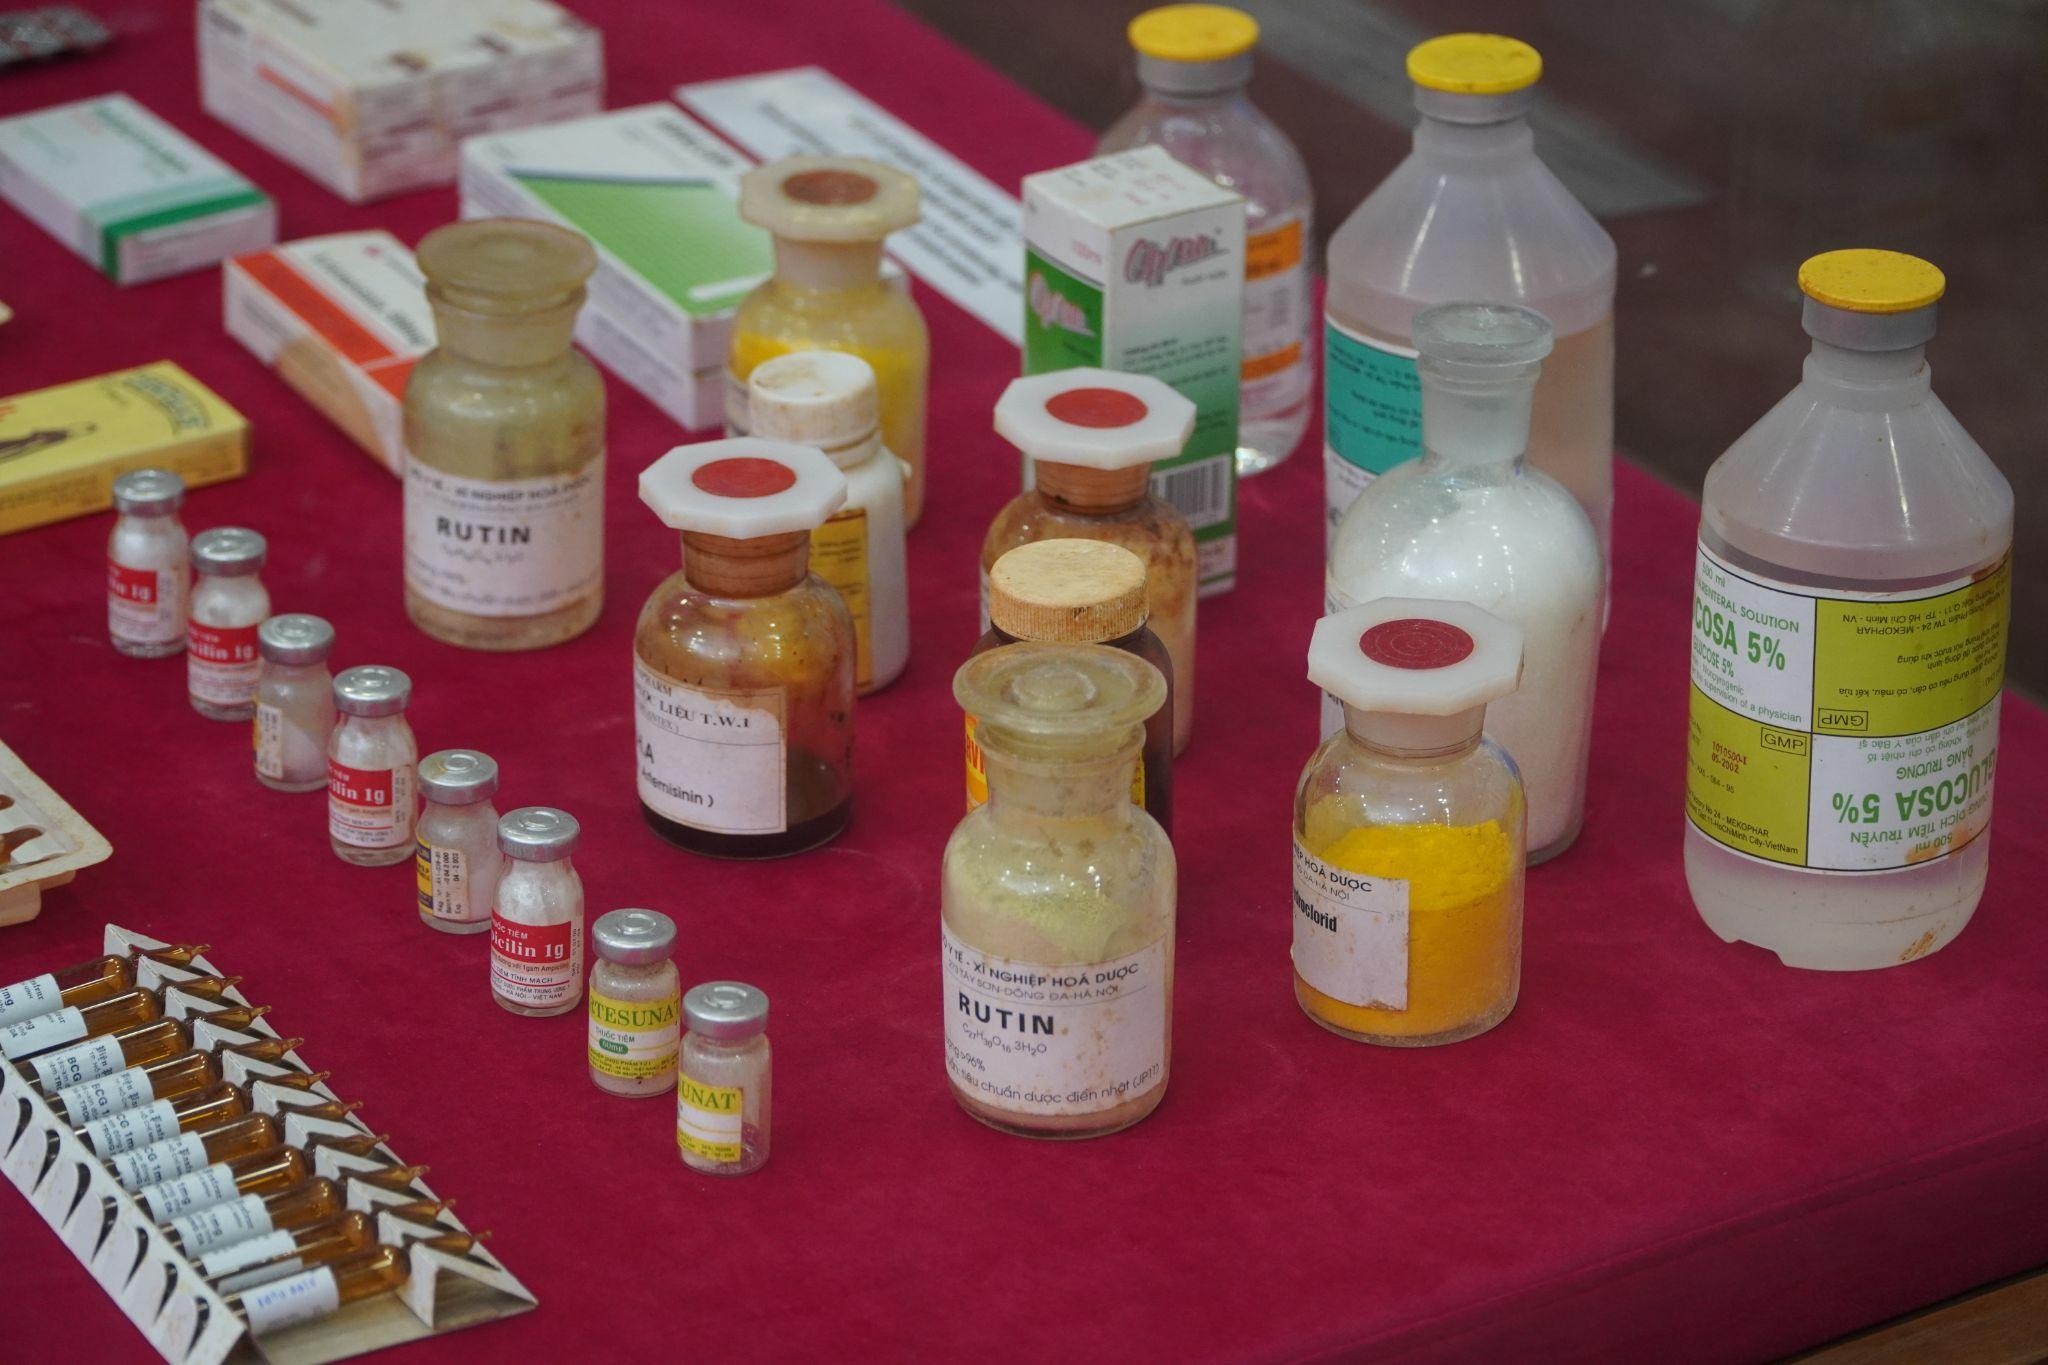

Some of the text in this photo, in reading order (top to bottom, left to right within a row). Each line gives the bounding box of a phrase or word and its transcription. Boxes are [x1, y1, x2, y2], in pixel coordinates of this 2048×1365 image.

[436, 516, 531, 544] RUTIN
[1715, 574, 1726, 588] ml
[1740, 606, 1800, 633] SOLUTION
[1843, 615, 1857, 623] VN
[1866, 614, 1888, 624] Minh
[1921, 622, 1931, 632] 24
[1933, 620, 1946, 630] TW
[1856, 625, 1914, 635] MEKOPHAR
[1748, 631, 1786, 671] 5%
[1897, 653, 1920, 664] dùng
[1921, 651, 1932, 661] khi
[1721, 658, 1734, 678] 5%
[1702, 664, 1745, 696] Nonpyrogenic
[1703, 678, 1802, 724] supervision of a physician
[1821, 714, 1864, 726] GMP
[1764, 733, 1804, 750] GMP
[1894, 739, 1902, 748] Y
[1832, 748, 1996, 824] GLUCOSA 5%
[365, 788, 385, 805] 1g
[1726, 815, 1769, 838] MEKOPHAR
[1851, 828, 1903, 848] TRUYỀN
[1915, 832, 1953, 853] 500 ml
[1330, 872, 1372, 892] DƯỢC
[508, 928, 528, 940] TIÊM
[545, 943, 564, 959] 1g
[989, 968, 1046, 988] NGHIỆP
[1096, 963, 1139, 983] DƯỢC
[959, 992, 1054, 1035] RUTIN
[617, 1033, 635, 1043] TIÊM
[67, 1056, 82, 1082] BCG
[981, 1079, 1021, 1101] chuẩn
[1024, 1089, 1061, 1104] dược
